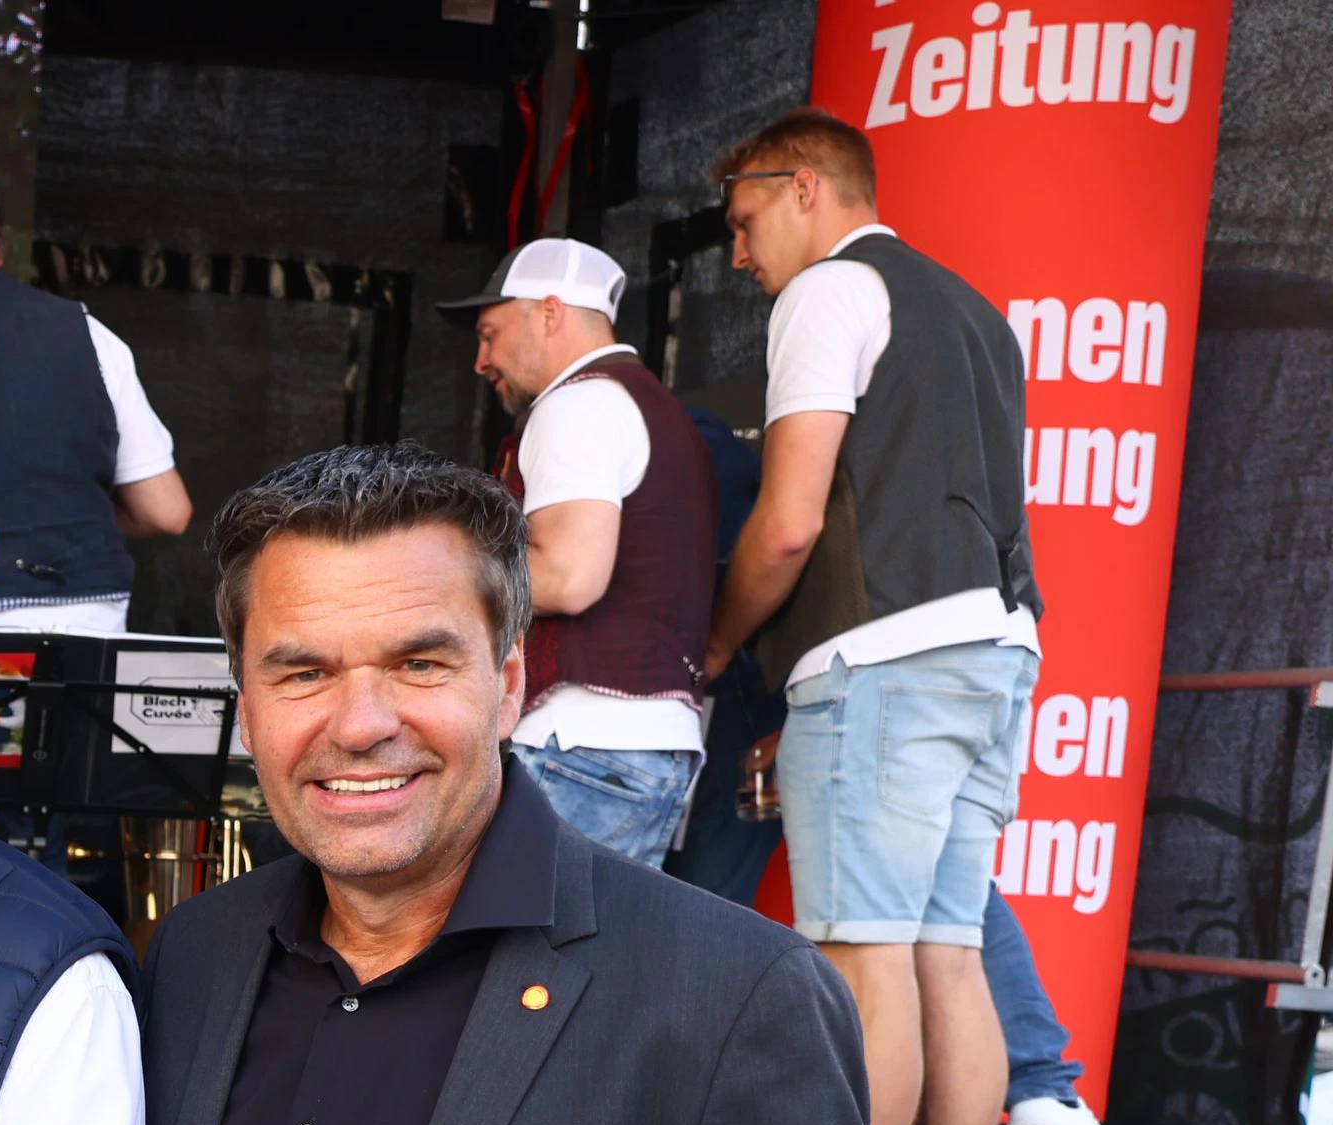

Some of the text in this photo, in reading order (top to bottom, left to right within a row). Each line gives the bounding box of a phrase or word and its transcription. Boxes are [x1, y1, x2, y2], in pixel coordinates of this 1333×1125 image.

[864, 2, 1197, 125] Zeitung
[1023, 427, 1158, 527] ung
[141, 707, 192, 719] Cuvée
[142, 695, 186, 707] Blech
[993, 819, 1117, 915] ung
